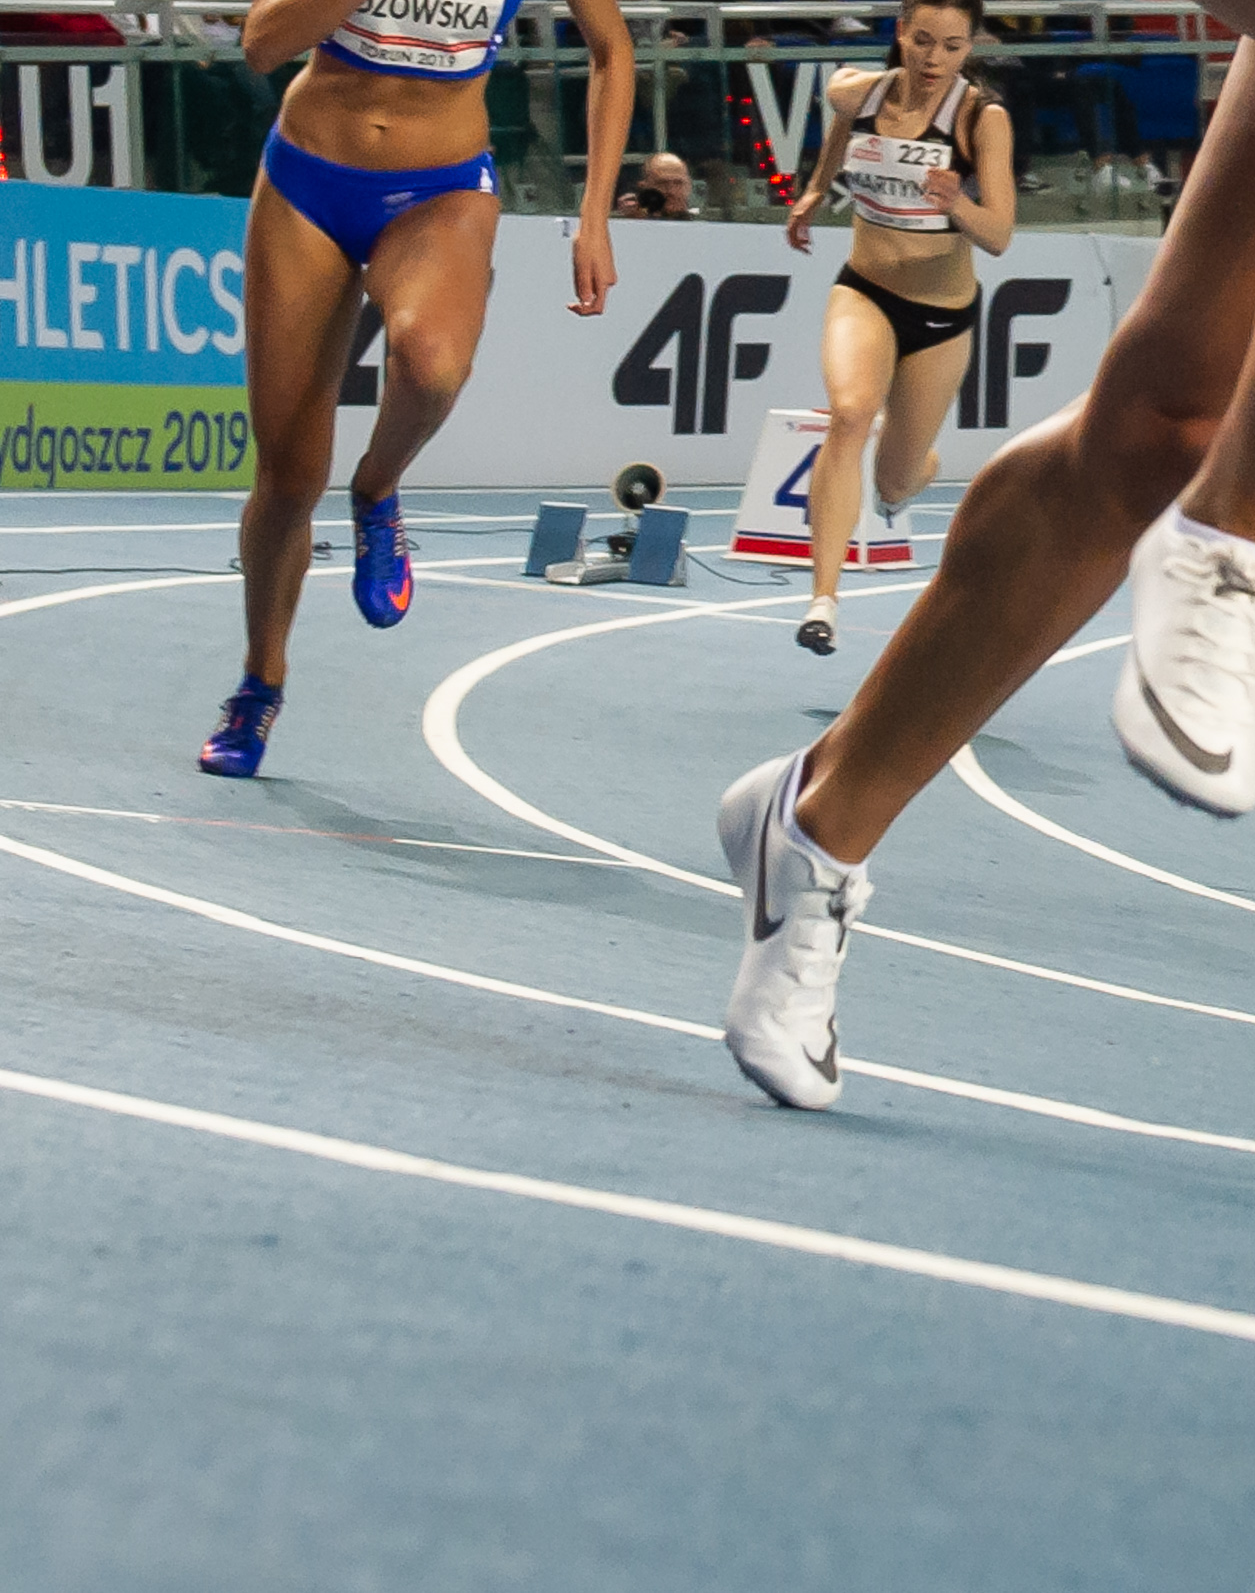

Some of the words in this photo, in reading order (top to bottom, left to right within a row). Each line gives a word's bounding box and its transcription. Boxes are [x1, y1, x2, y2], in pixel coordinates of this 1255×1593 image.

[418, 52, 457, 67] 2019
[898, 144, 942, 166] 223
[612, 273, 791, 435] 4F
[957, 279, 1072, 429] F
[163, 410, 248, 473] 2019
